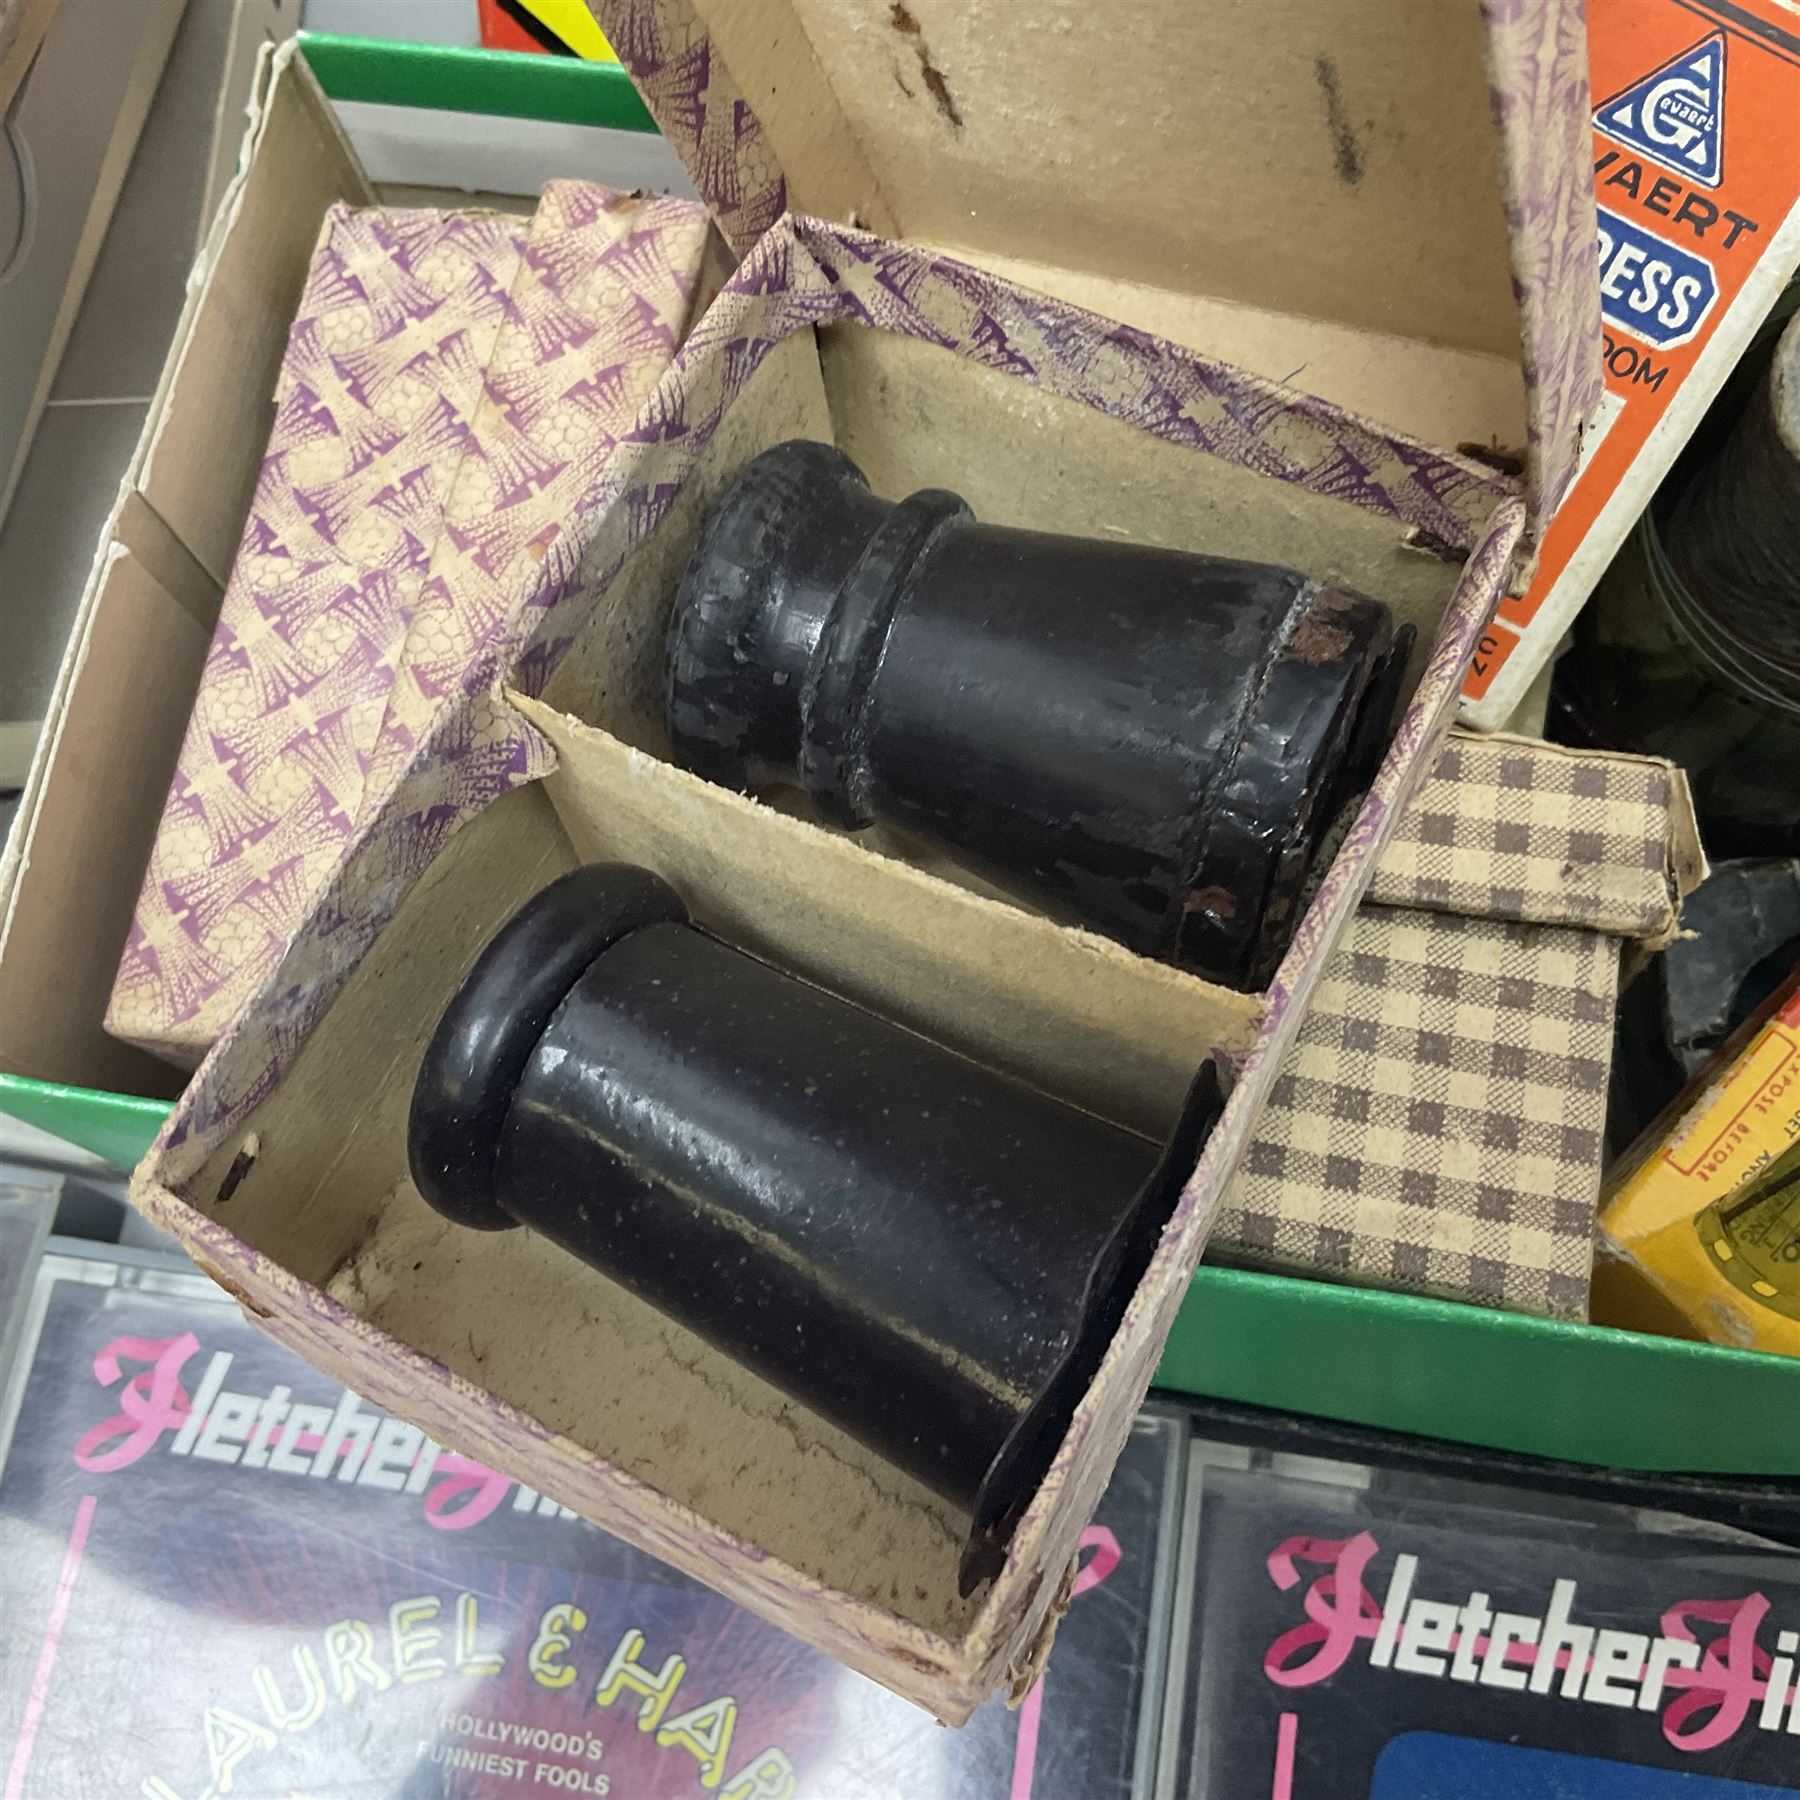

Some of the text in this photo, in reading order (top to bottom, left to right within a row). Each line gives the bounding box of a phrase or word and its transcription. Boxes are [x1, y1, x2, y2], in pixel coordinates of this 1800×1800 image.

[1696, 1053, 1800, 1182] XPOSE BEFORE
[1264, 1530, 1700, 1712] Fletcher
[141, 1592, 505, 1800] AUREL
[440, 1712, 604, 1761] HOLLYWOOD'S
[416, 1741, 610, 1796] FUNNIEST FOOLS
